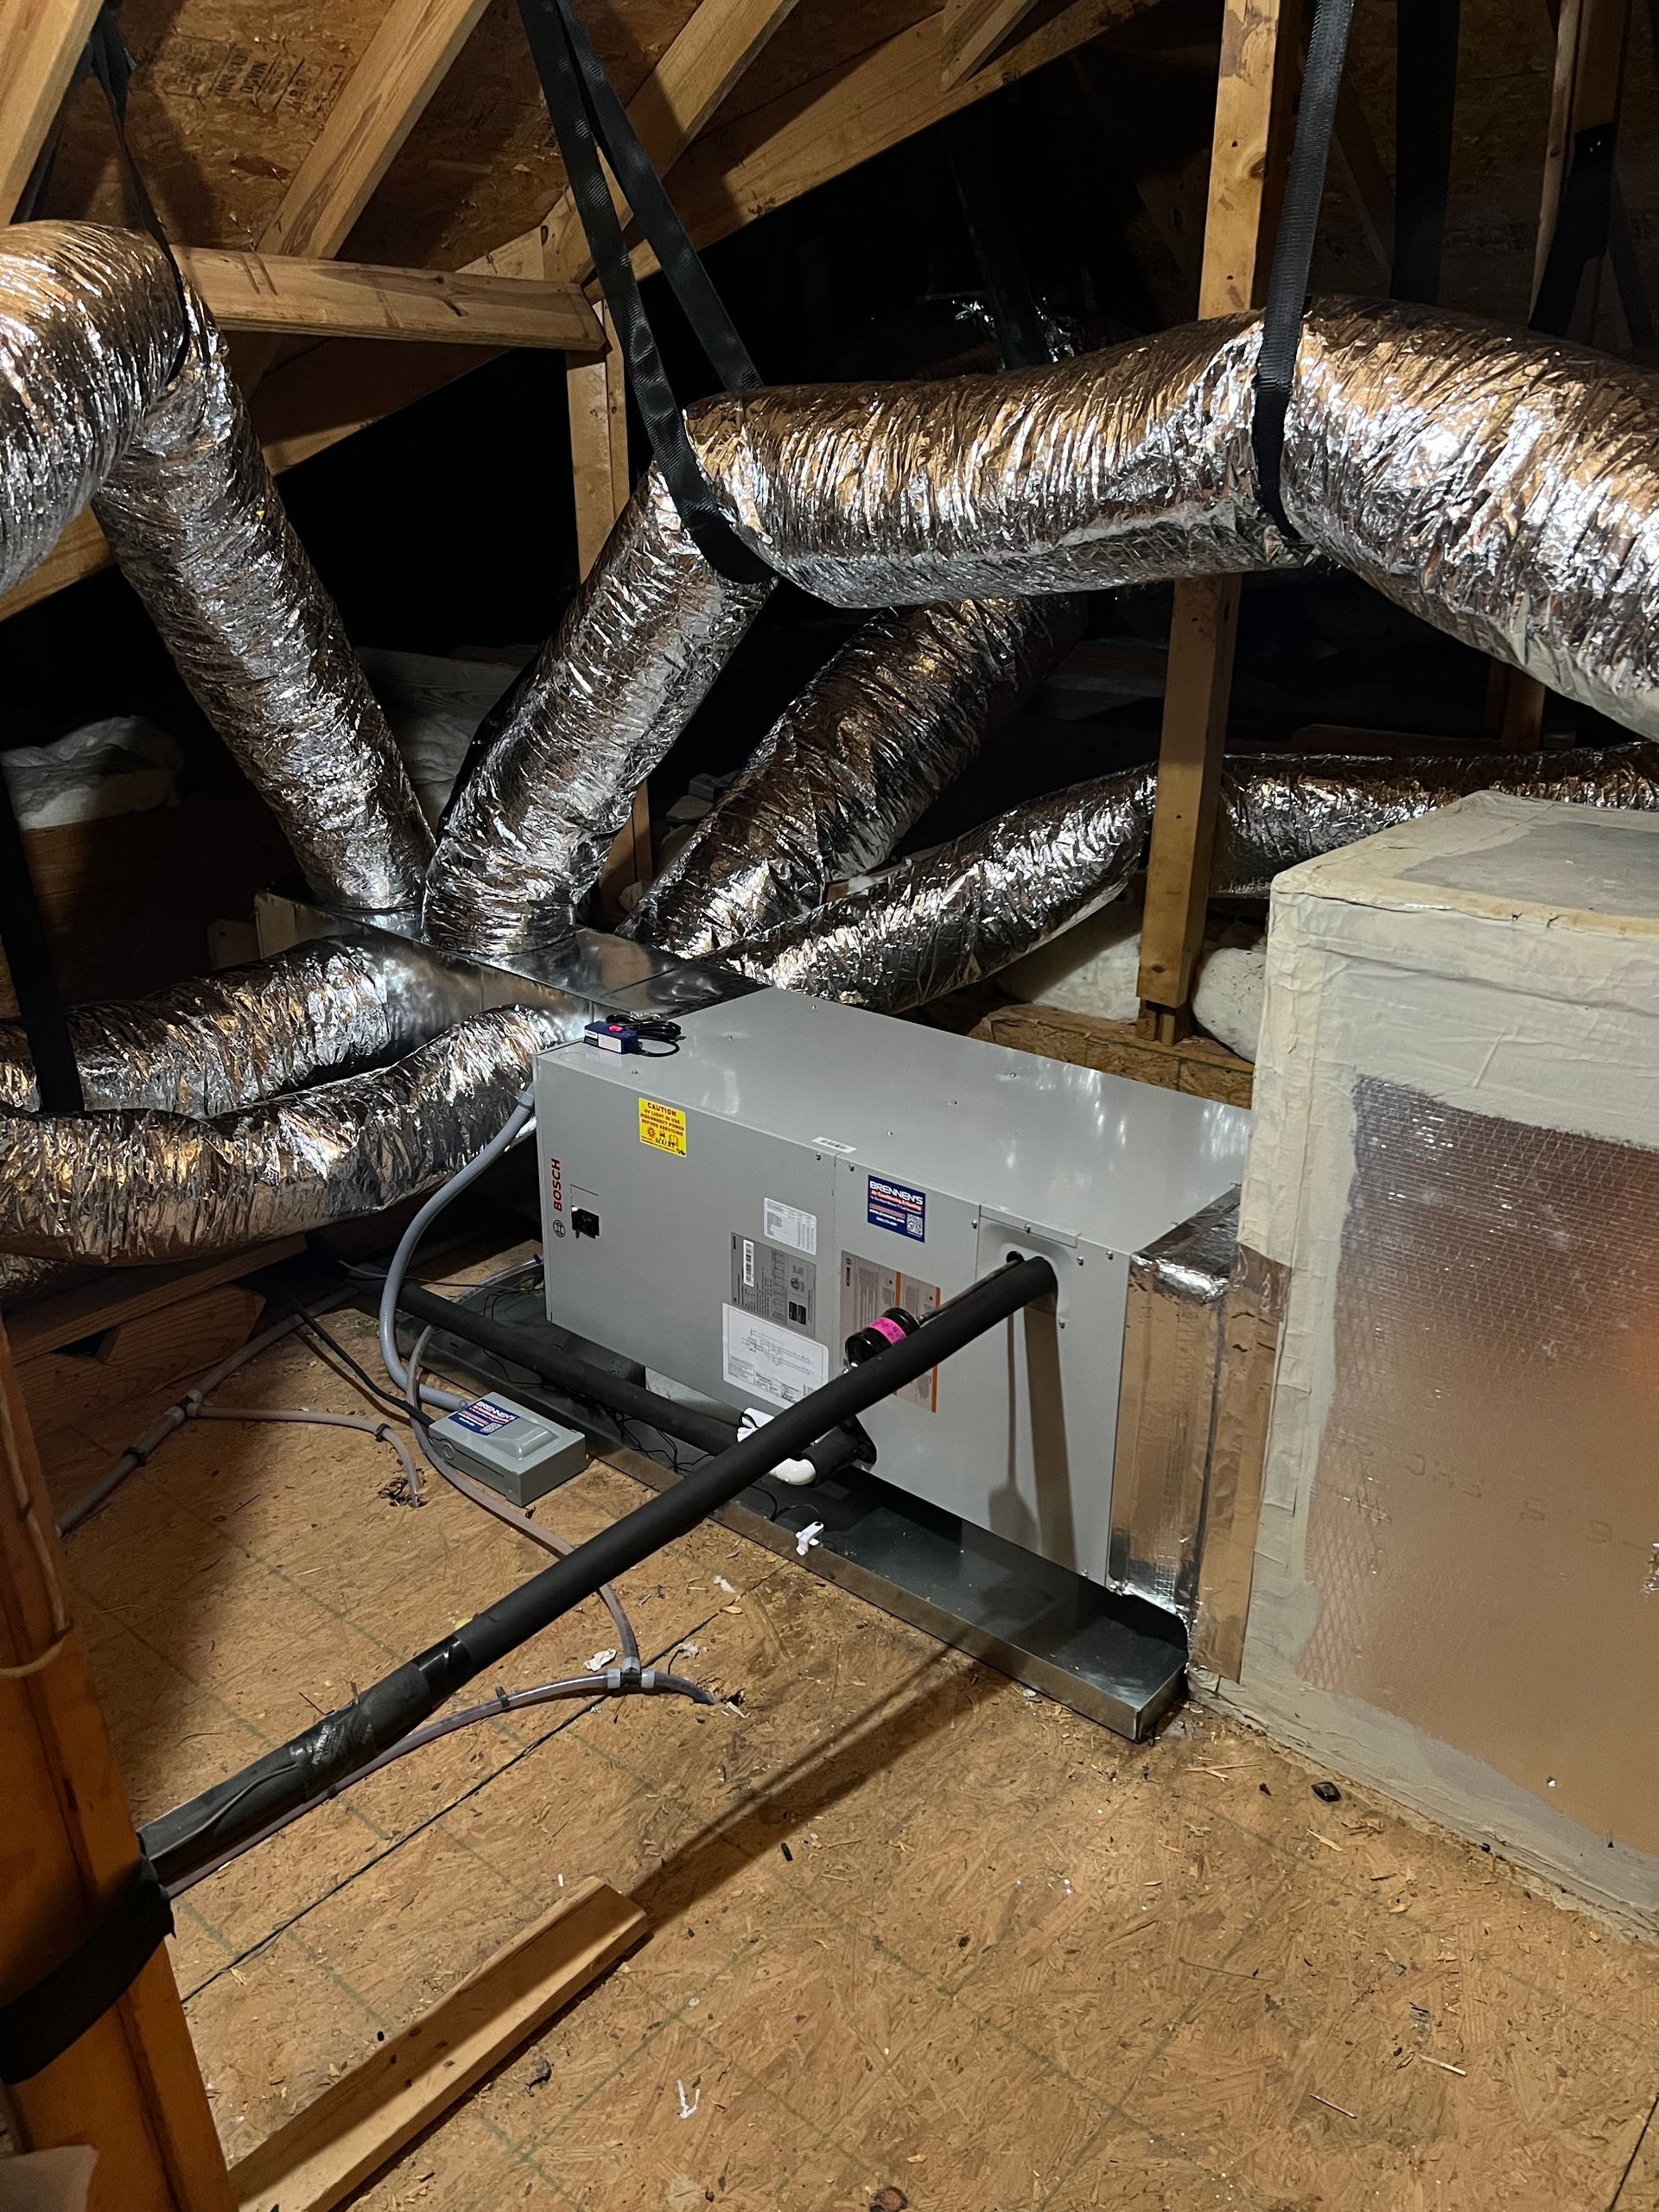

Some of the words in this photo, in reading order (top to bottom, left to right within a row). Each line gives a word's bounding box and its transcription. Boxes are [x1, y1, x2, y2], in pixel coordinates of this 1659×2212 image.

[648, 1103, 676, 1116] CAUTION
[551, 1158, 562, 1211] BOSCH
[869, 1179, 923, 1205] BRENNEN'S
